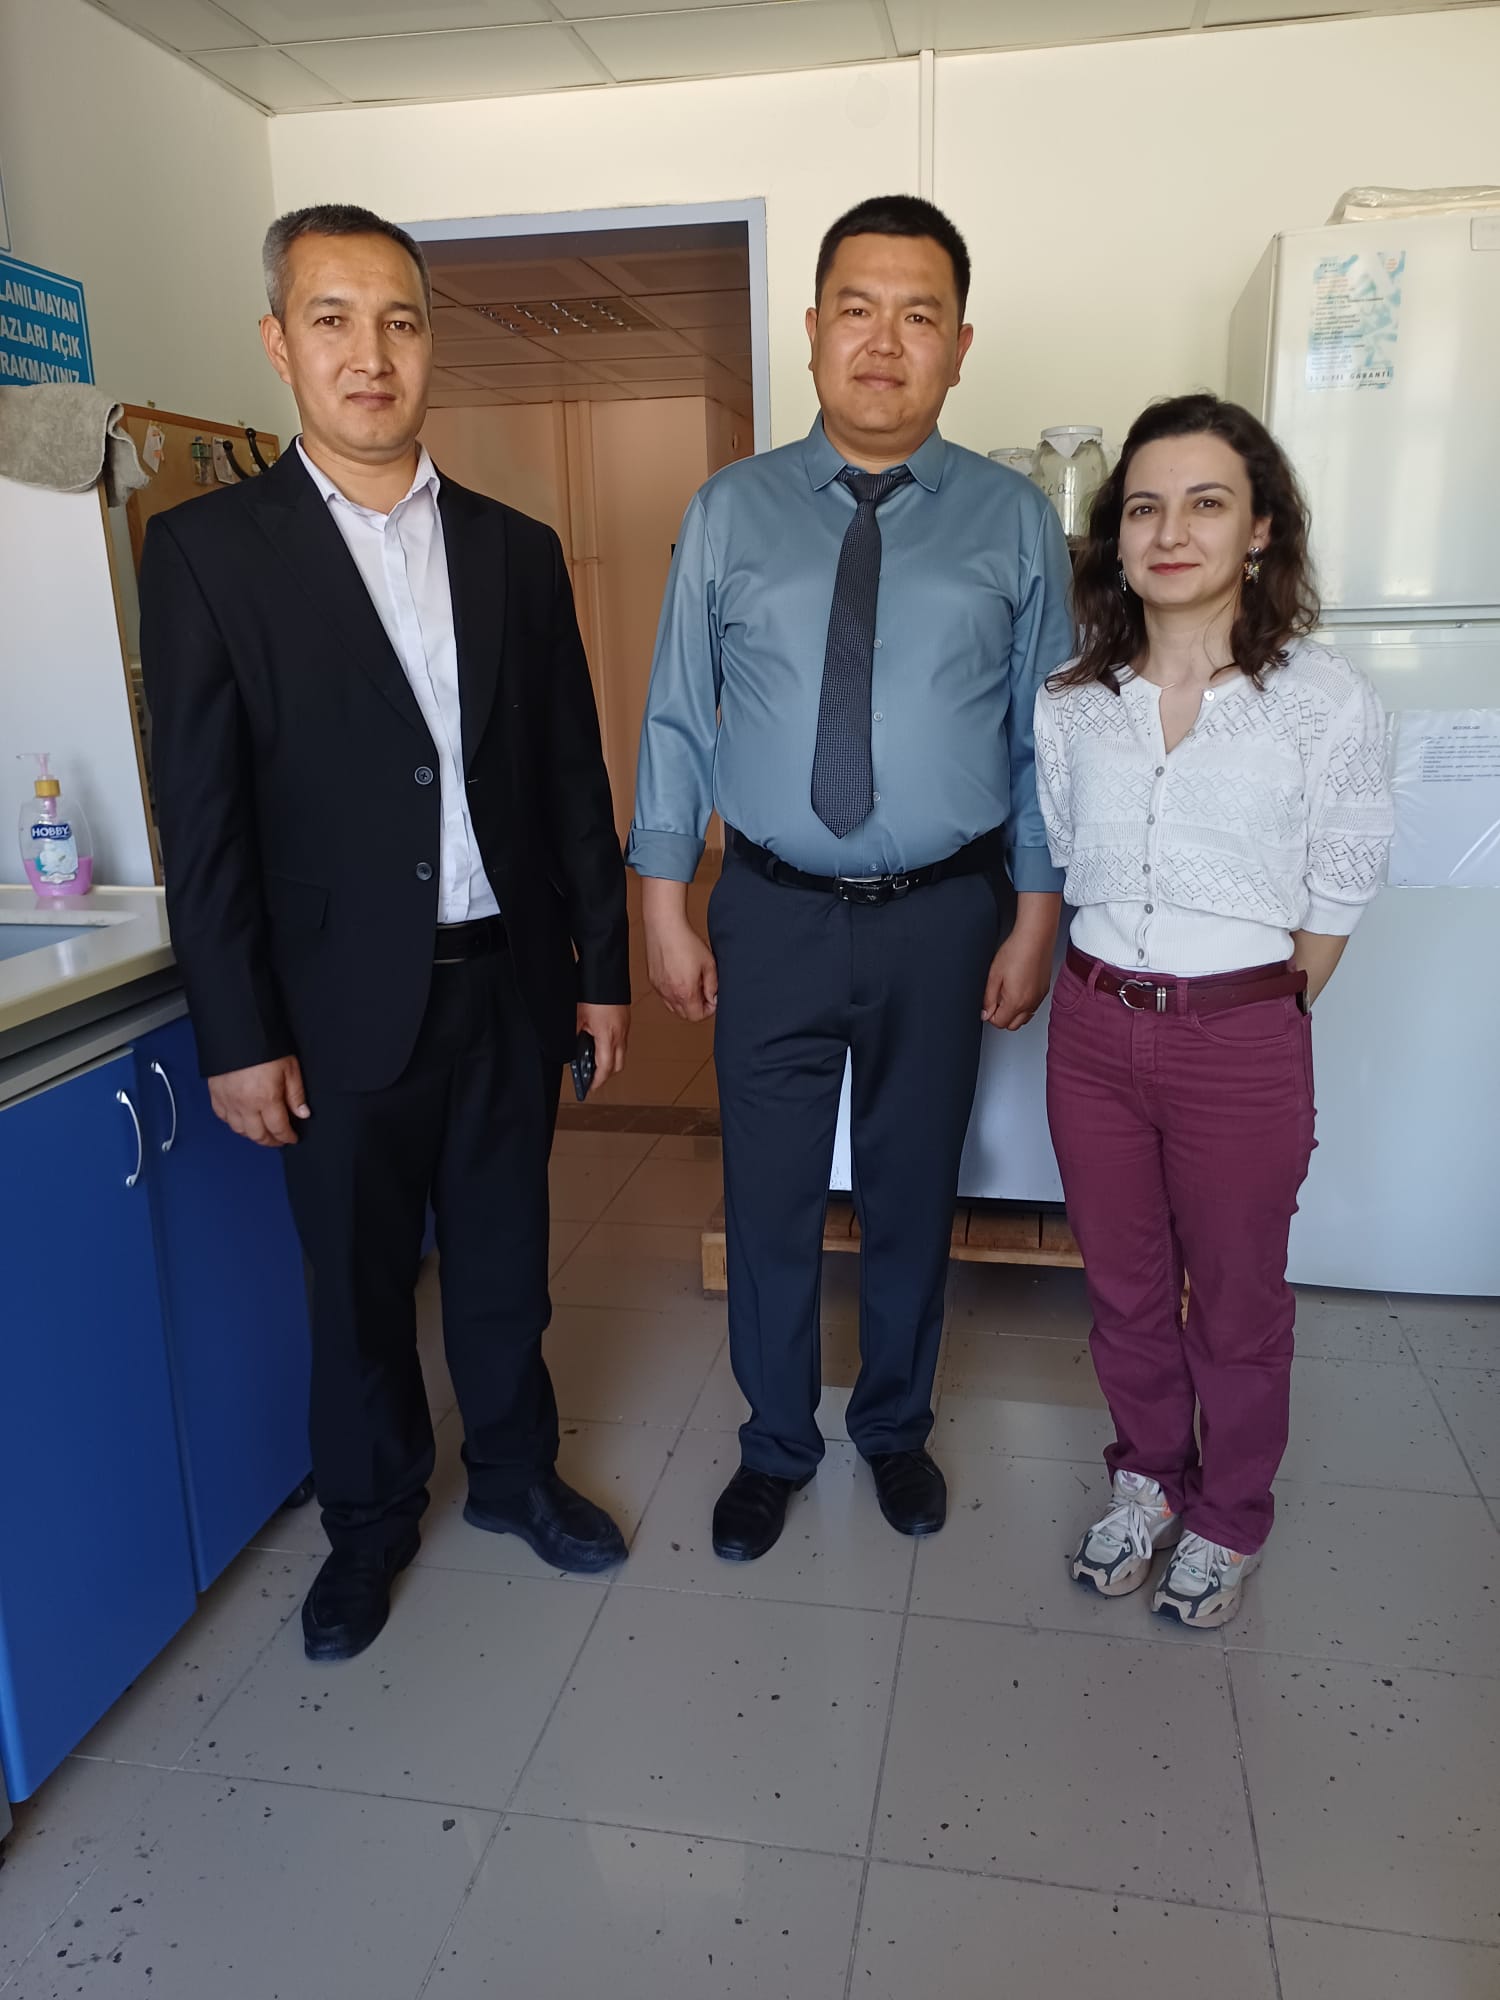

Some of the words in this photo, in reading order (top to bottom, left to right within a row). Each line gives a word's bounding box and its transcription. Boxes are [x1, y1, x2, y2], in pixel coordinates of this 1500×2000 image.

[0, 314, 48, 350] AZLARI
[52, 330, 82, 360] AÇIK
[32, 826, 68, 837] HOBBY
